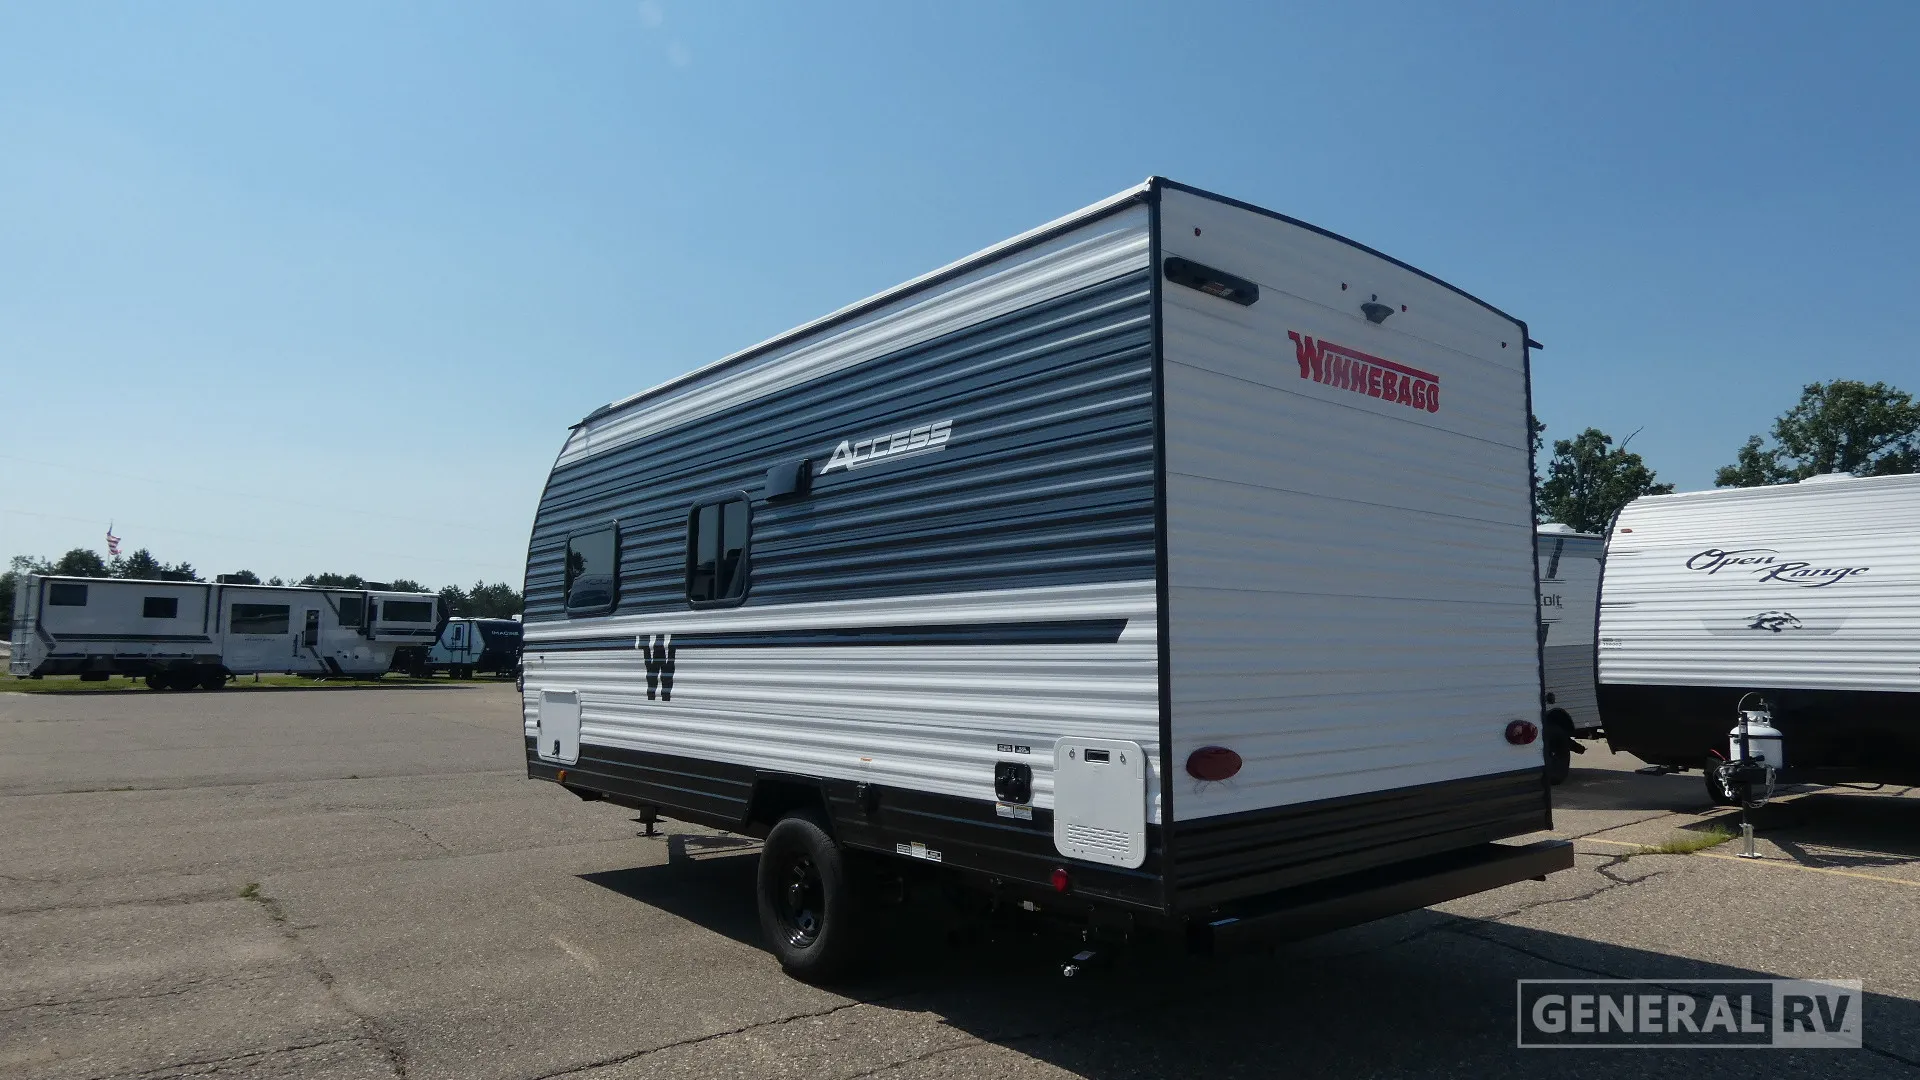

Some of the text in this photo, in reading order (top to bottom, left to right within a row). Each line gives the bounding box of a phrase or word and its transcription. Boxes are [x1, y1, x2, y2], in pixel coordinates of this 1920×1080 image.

[1288, 330, 1439, 413] WINNEBAGO
[820, 420, 953, 474] ACCESS
[1686, 549, 1870, 587] Open Range
